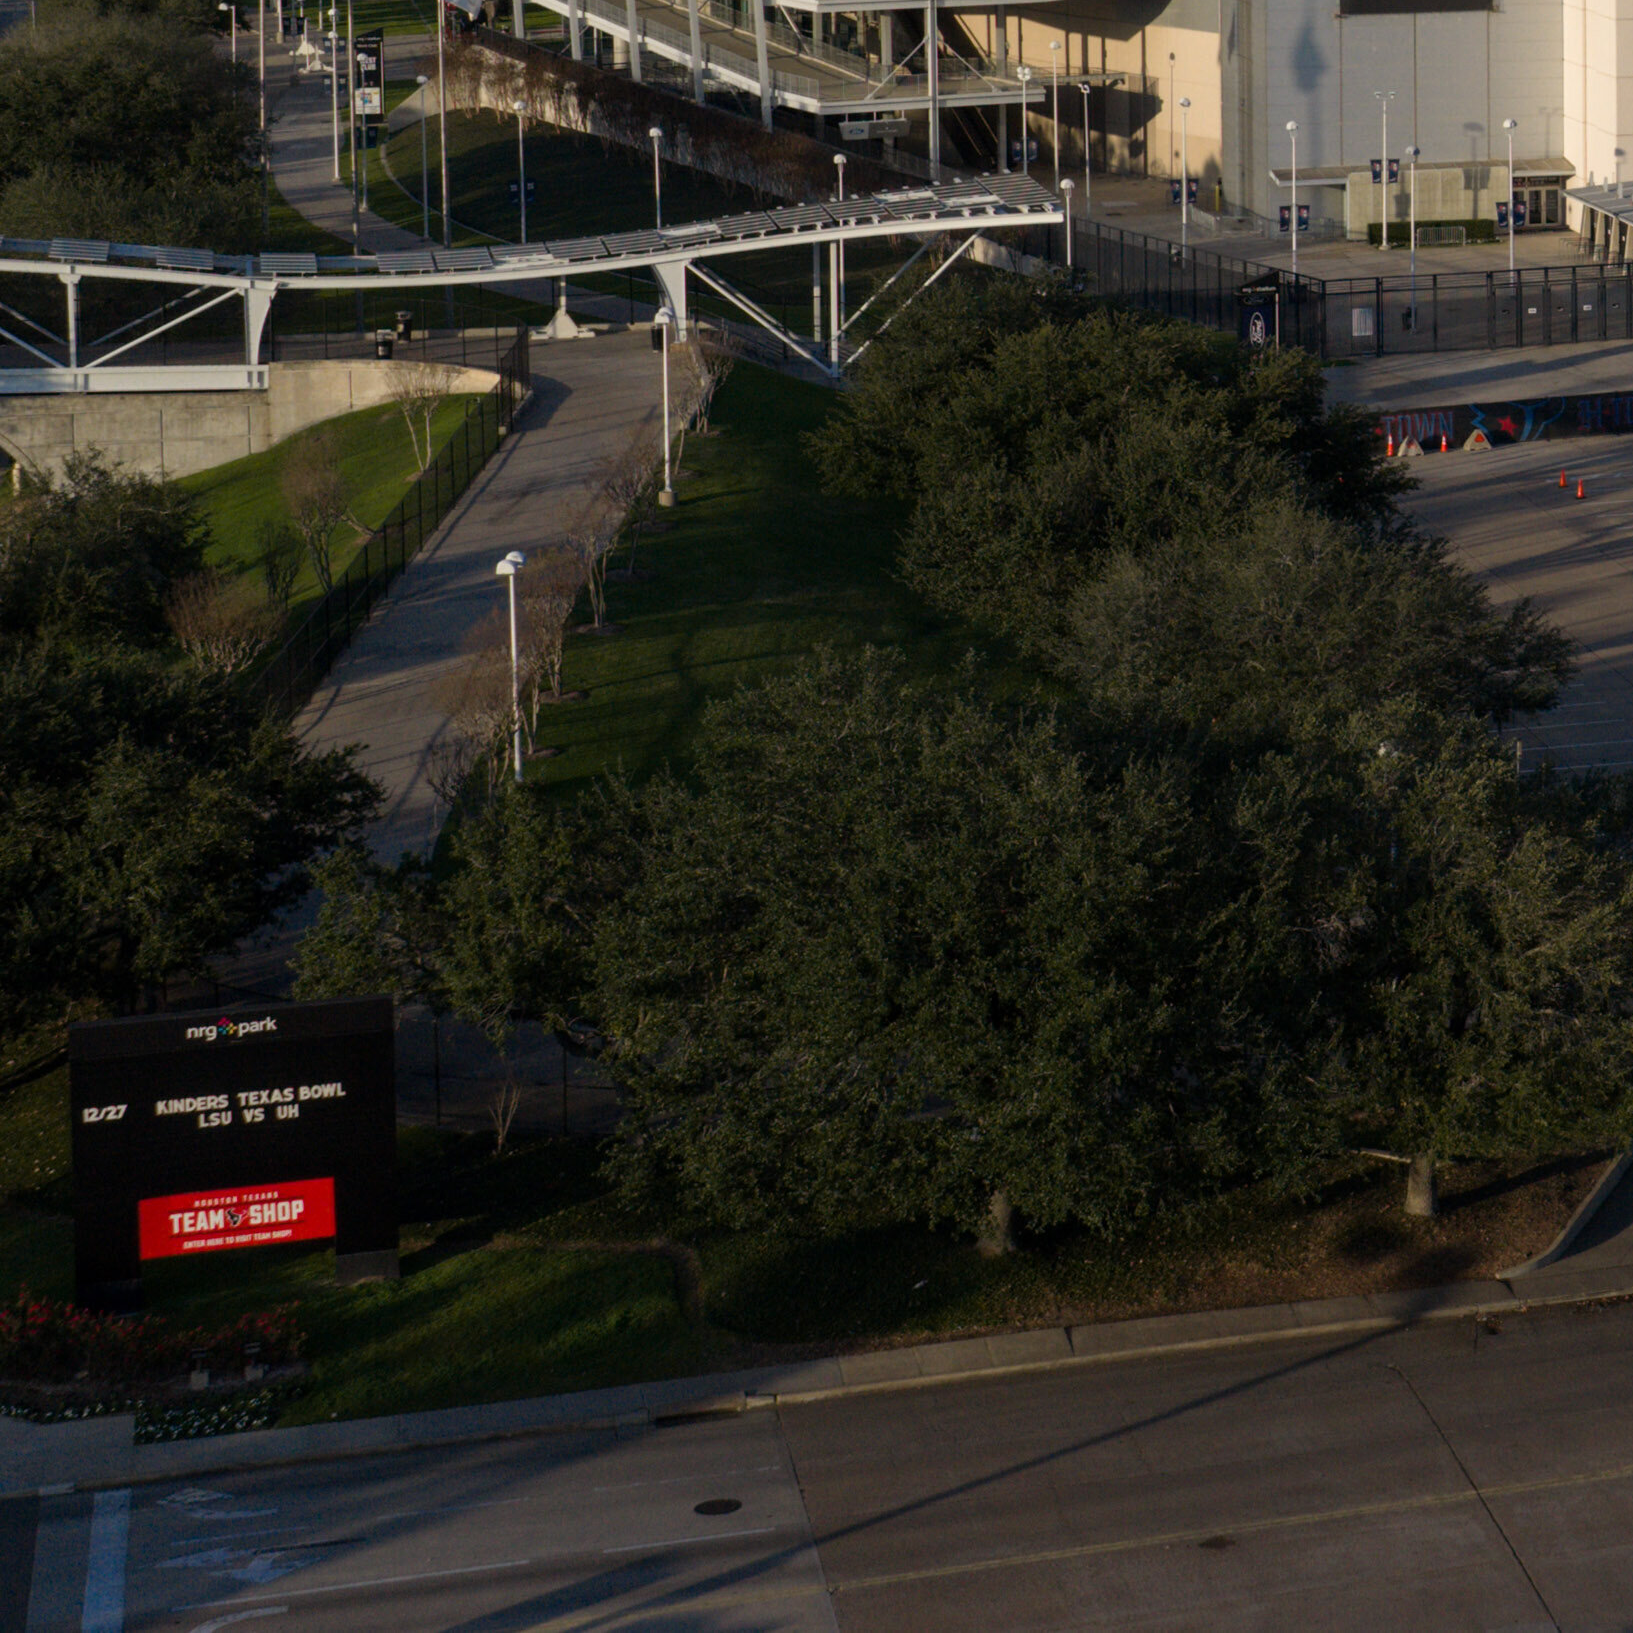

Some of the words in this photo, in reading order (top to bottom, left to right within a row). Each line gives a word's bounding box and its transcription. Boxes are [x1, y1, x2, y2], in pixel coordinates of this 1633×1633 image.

[186, 1023, 217, 1042] nrg
[237, 1016, 278, 1041] park
[155, 1094, 230, 1116] KINDERS
[237, 1086, 295, 1108] TEXAS
[297, 1082, 347, 1102] BOWL
[82, 1104, 128, 1124] 12/27
[198, 1110, 233, 1129] LSU
[241, 1107, 266, 1124] VS
[275, 1103, 300, 1121] UH
[168, 1207, 225, 1236] TEAM
[248, 1198, 305, 1226] SHOP
